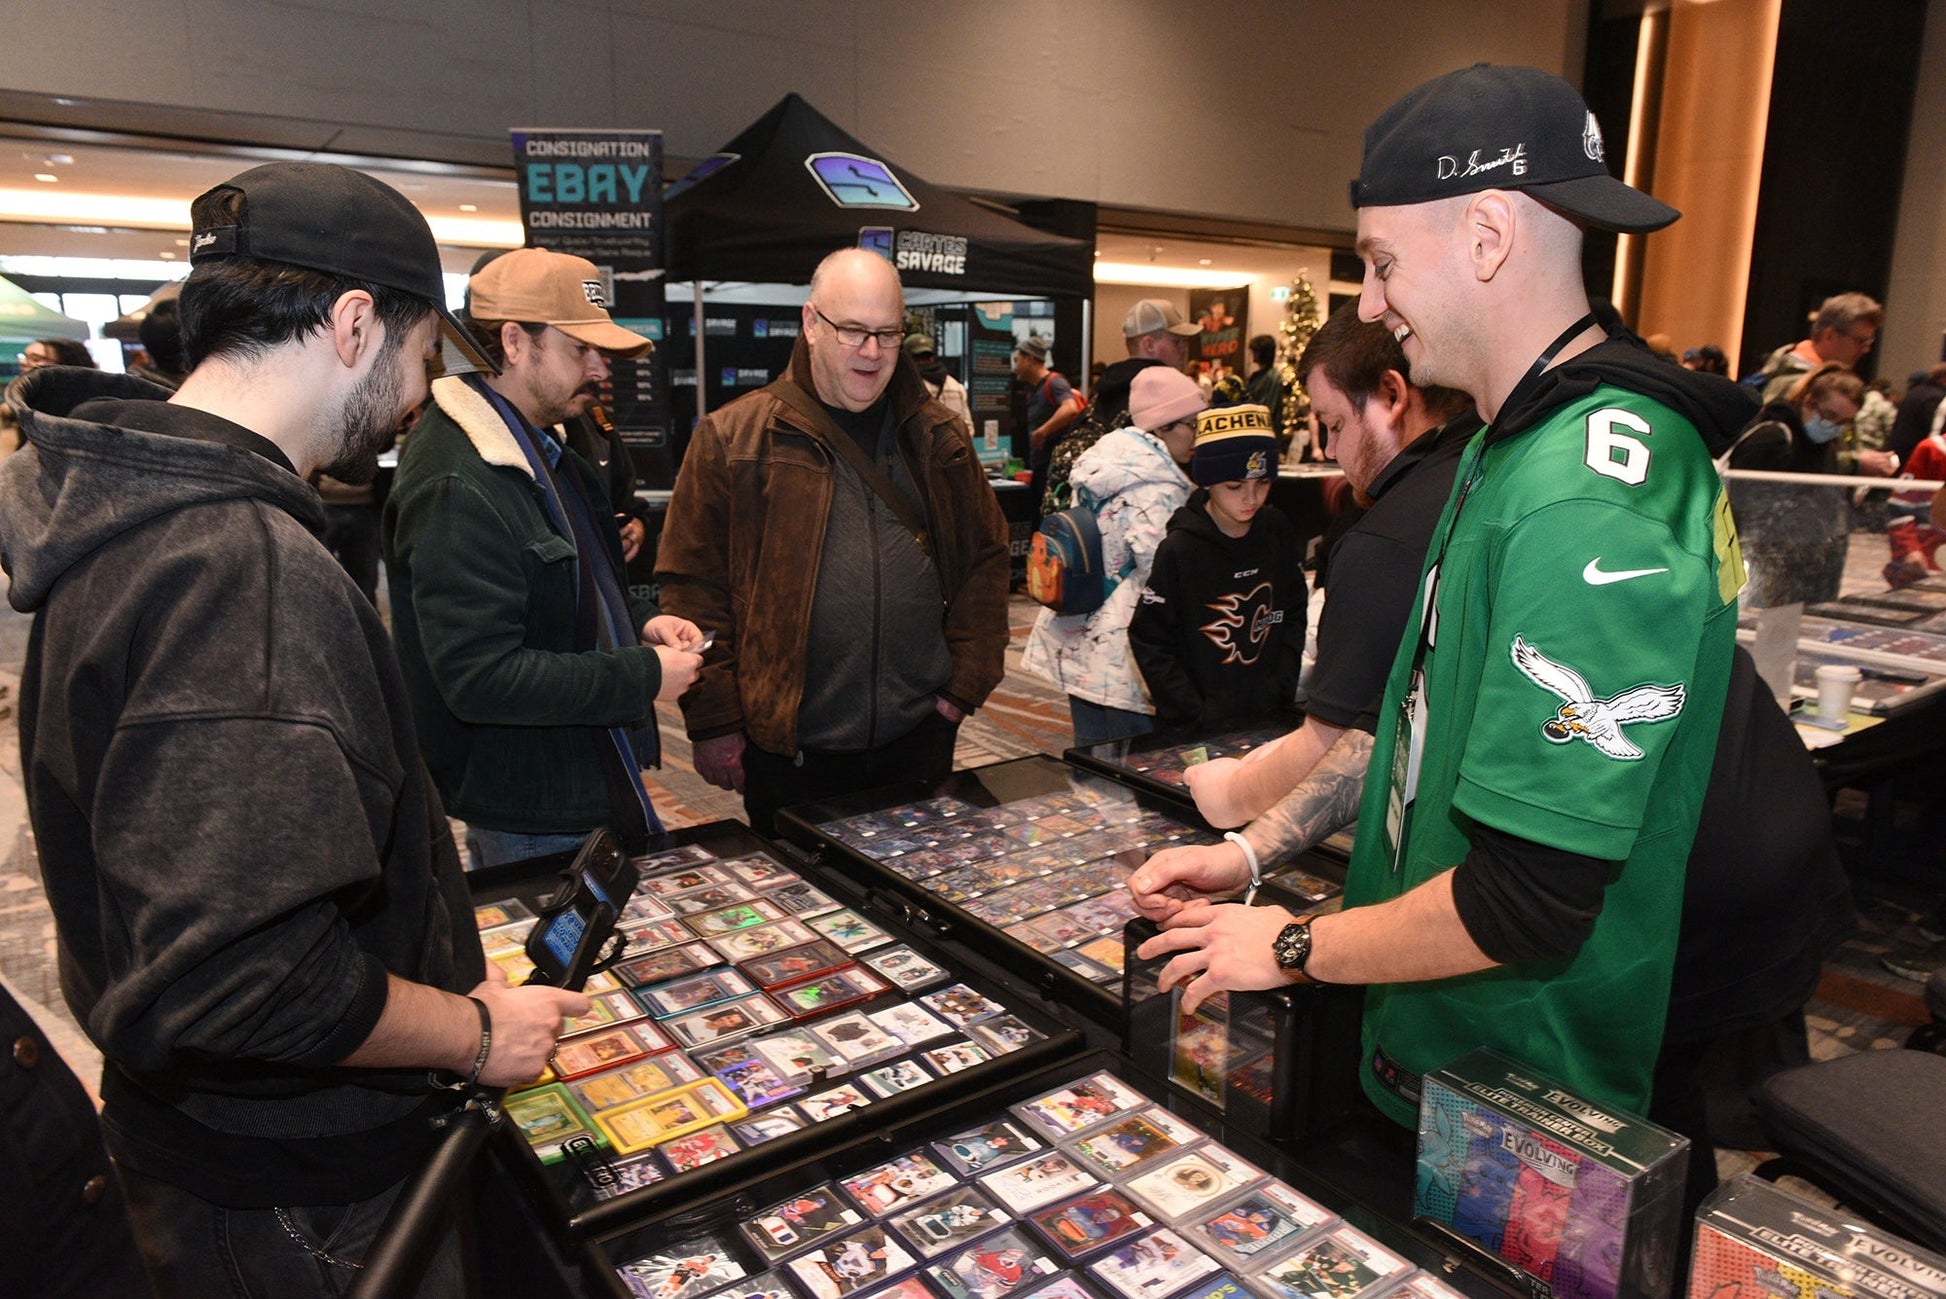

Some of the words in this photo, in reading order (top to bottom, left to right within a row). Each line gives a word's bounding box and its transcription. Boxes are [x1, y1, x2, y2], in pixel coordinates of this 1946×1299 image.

[526, 140, 649, 157] CONSIGNATION
[1512, 159, 1527, 176] 6
[526, 163, 648, 204] EBAY
[529, 211, 651, 228] CONSIGNMENT
[897, 250, 966, 275] SAVAGE
[1583, 407, 1652, 487] 6
[1472, 1084, 1508, 1105] ELITE
[1510, 1102, 1573, 1137] TRAINER
[1572, 1132, 1608, 1154] BOX
[1550, 1090, 1622, 1129] EVOLVING
[1504, 1132, 1574, 1175] EVOLVING
[1760, 1230, 1811, 1258] ELITE
[1854, 1239, 1946, 1282] EVOLVIN
